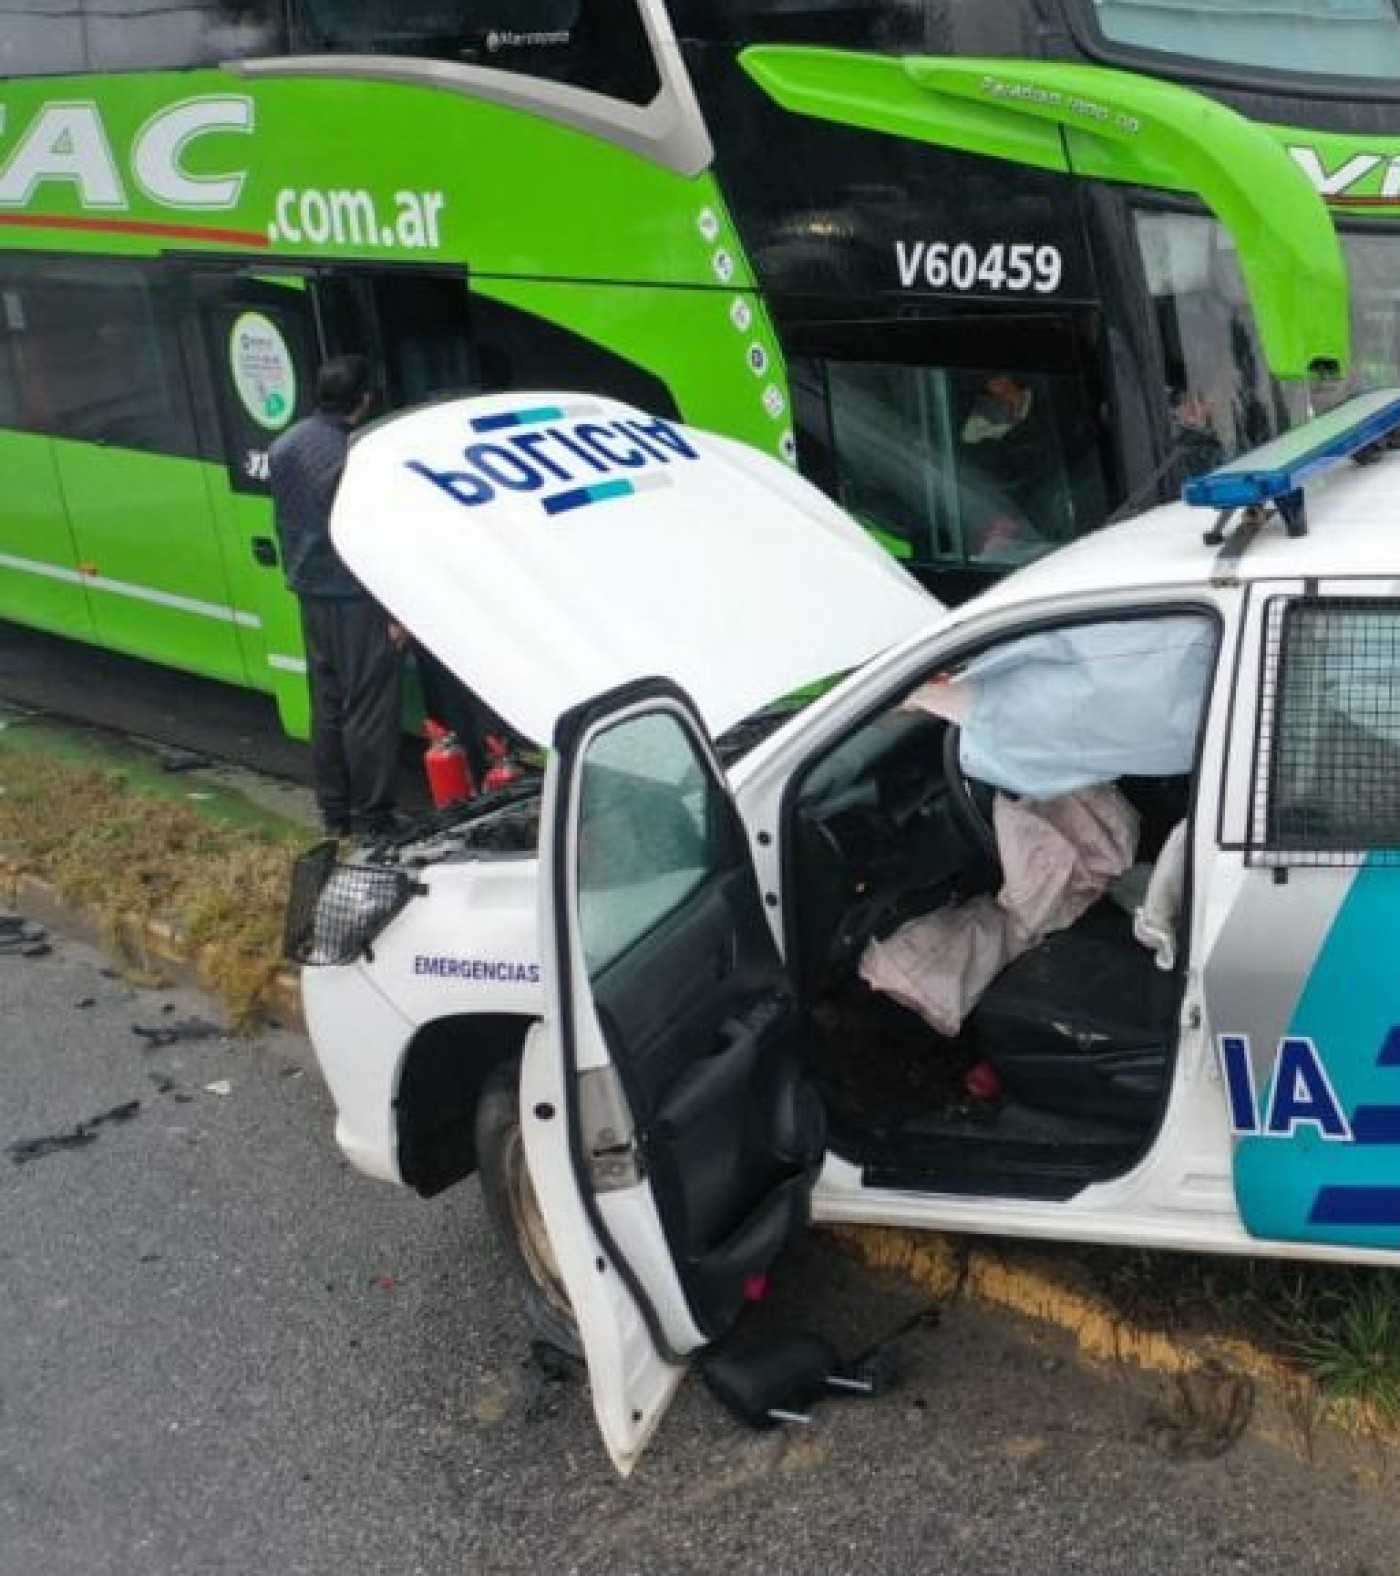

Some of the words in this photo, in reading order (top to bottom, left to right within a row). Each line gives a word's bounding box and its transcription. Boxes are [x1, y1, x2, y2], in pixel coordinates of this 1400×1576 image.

[0, 92, 255, 212] AC
[267, 187, 444, 249] .com.ar
[895, 240, 1063, 294] V60459
[413, 954, 541, 983] EMERGENCIAS
